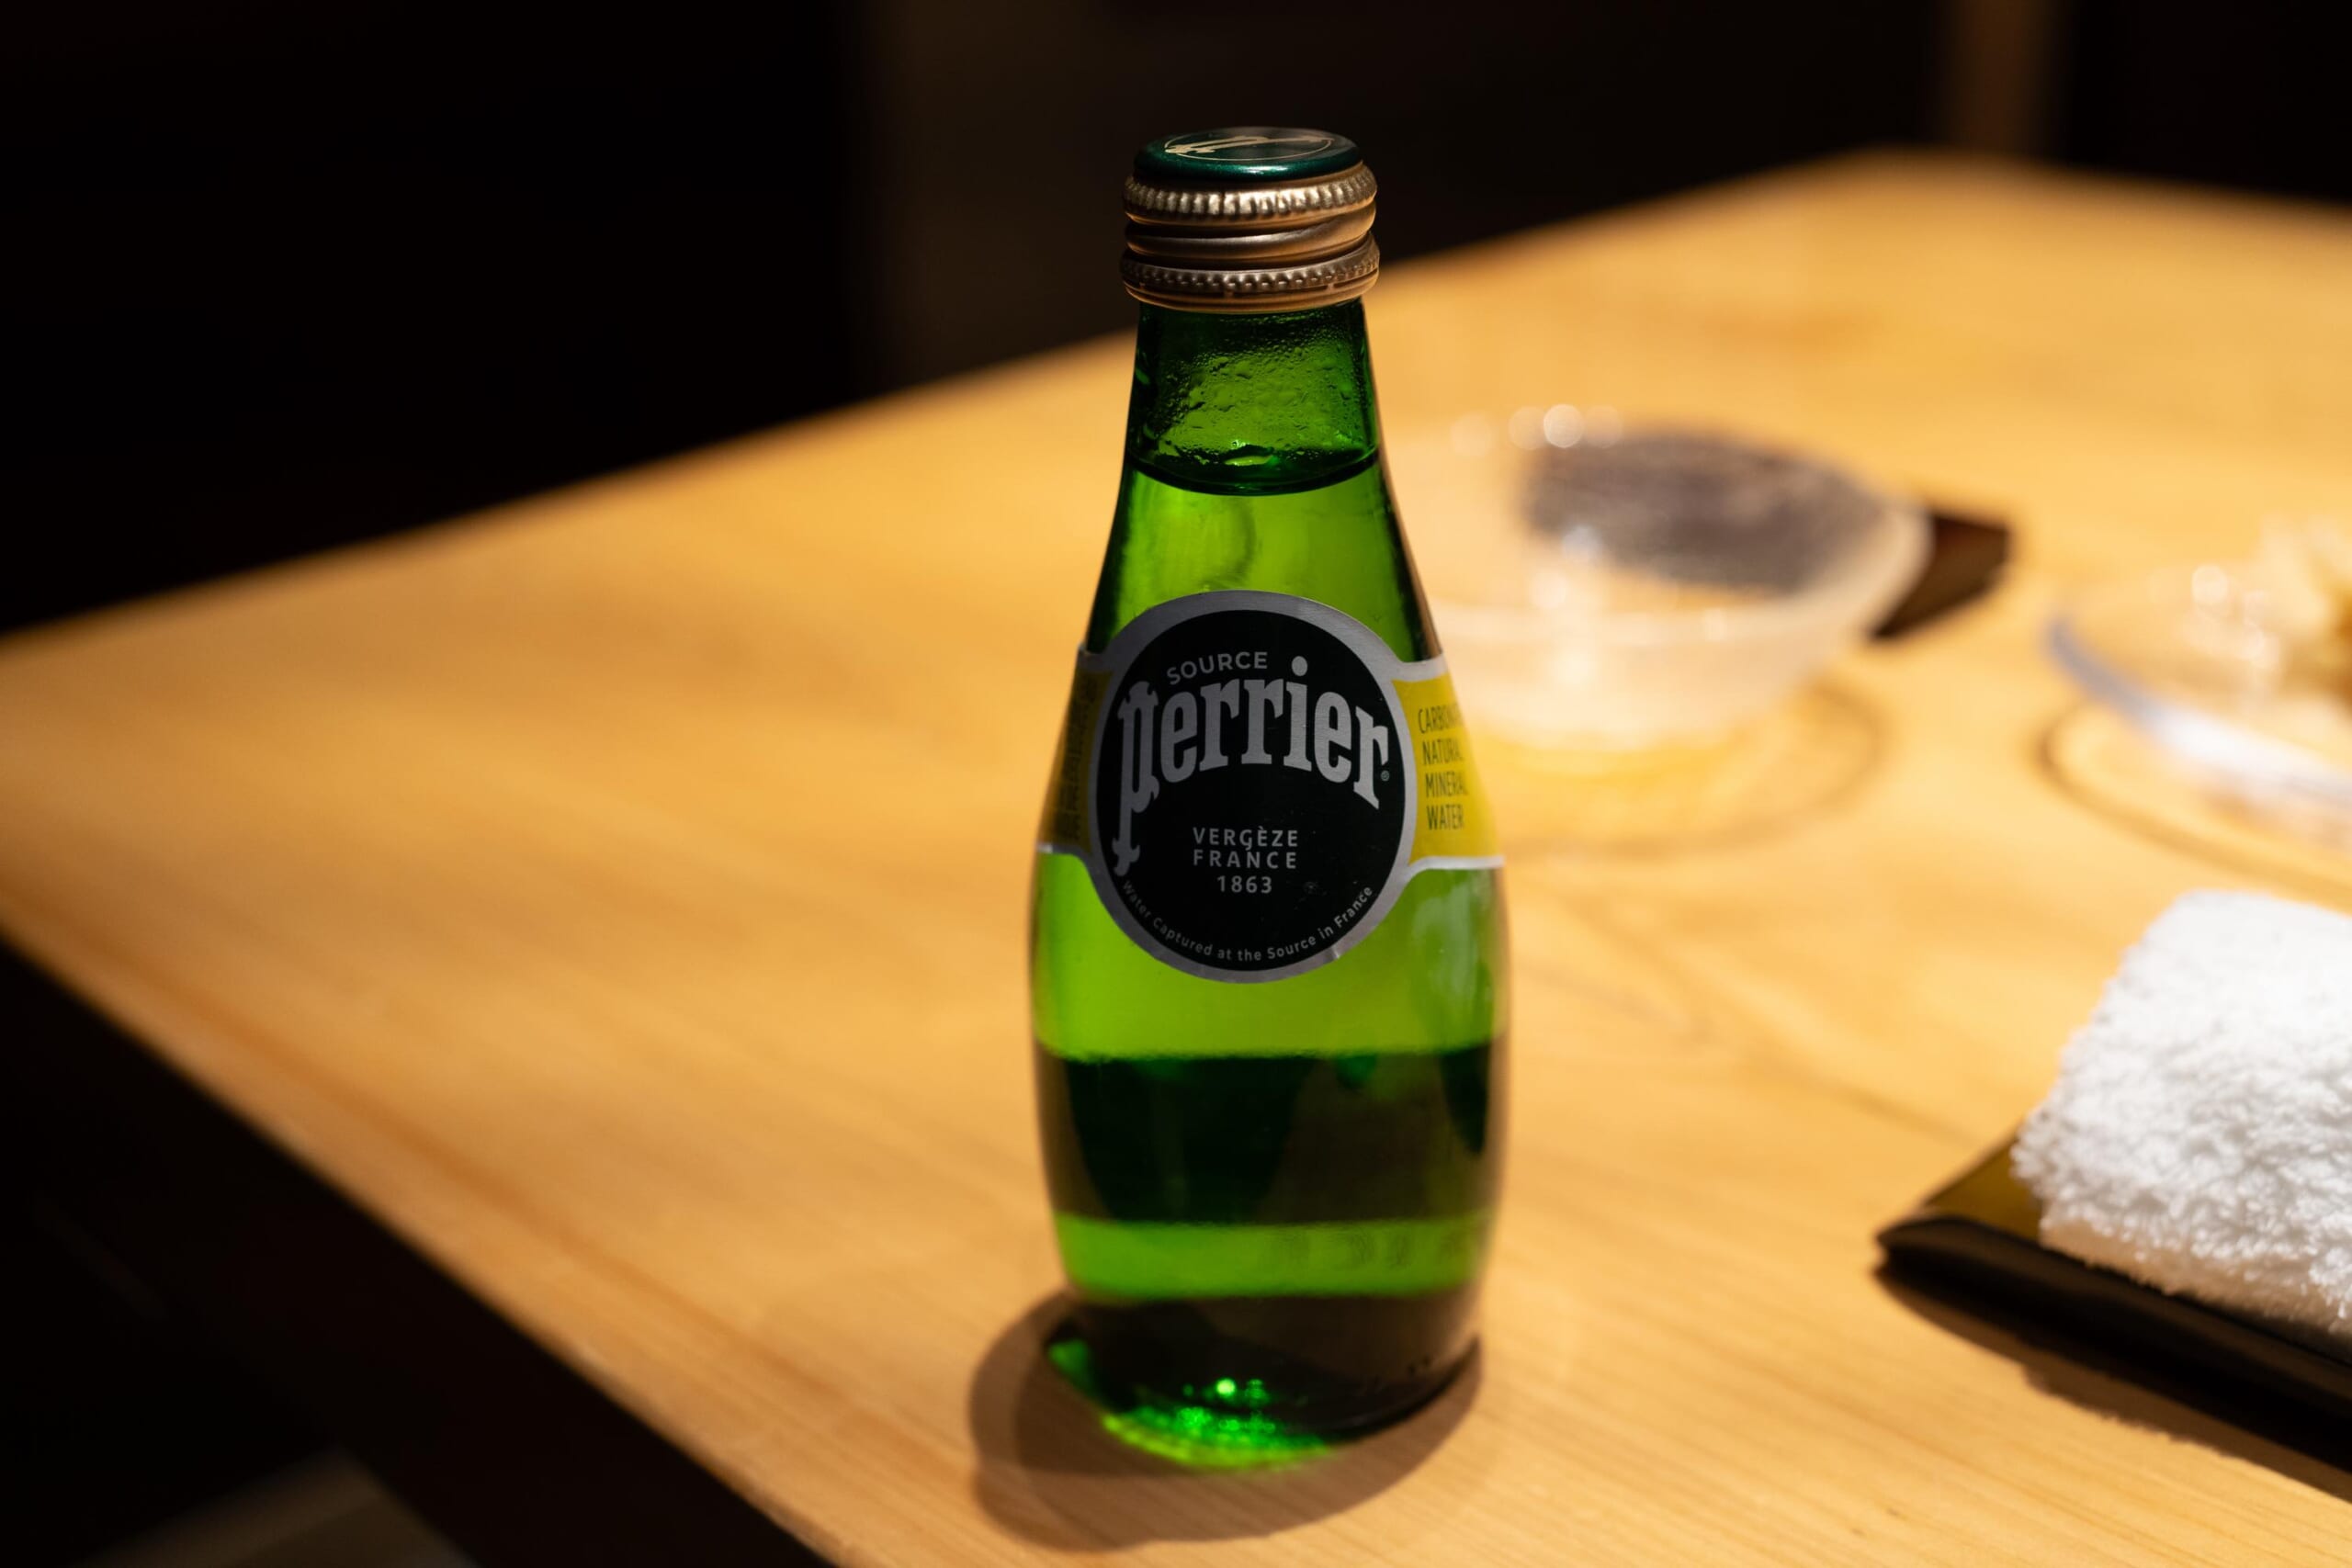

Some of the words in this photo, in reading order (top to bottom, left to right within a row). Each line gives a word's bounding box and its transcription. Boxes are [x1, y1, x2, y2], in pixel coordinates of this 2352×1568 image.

[1166, 650, 1268, 685] SOURCE
[1427, 804, 1464, 830] WATER
[1193, 825, 1298, 851] VERGÈZE
[1193, 849, 1296, 869] FRANCE
[1217, 875, 1272, 894] 1863
[1123, 879, 1152, 919] Water
[1153, 917, 1214, 956] Captured
[1217, 948, 1232, 961] at
[1238, 947, 1262, 962] the
[1267, 935, 1317, 959] Source
[1317, 926, 1334, 939] in
[1333, 886, 1373, 928] France
